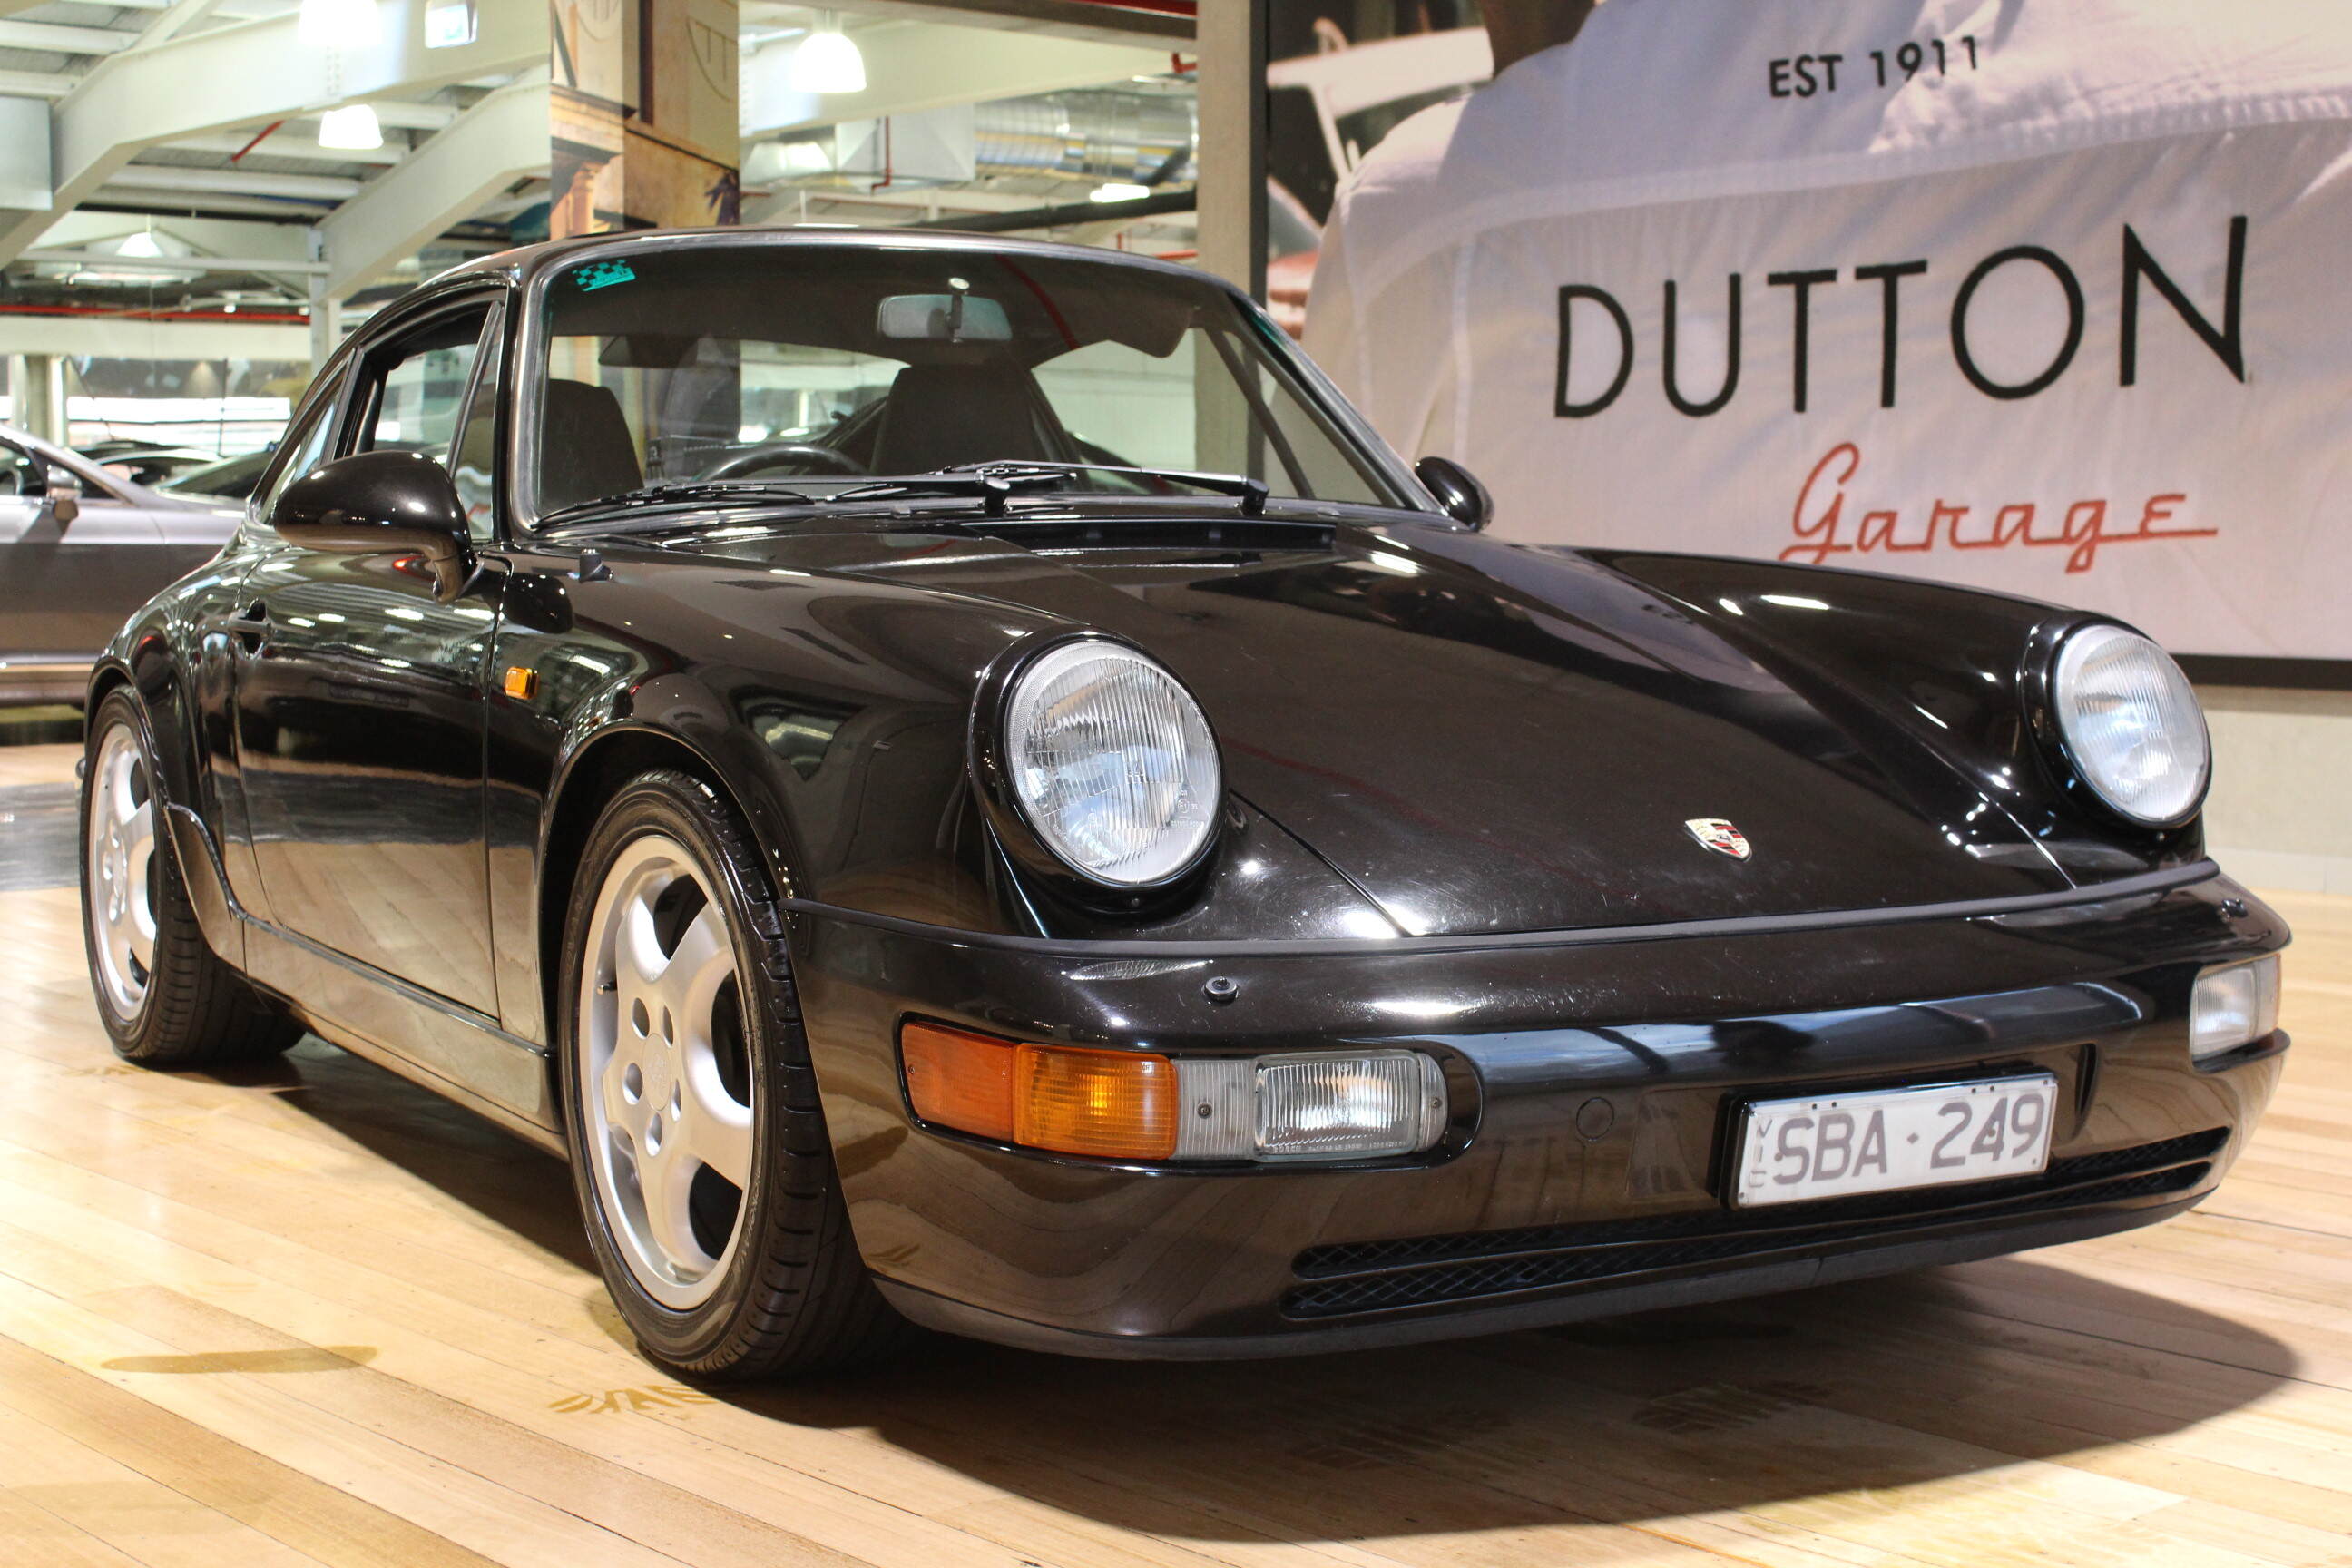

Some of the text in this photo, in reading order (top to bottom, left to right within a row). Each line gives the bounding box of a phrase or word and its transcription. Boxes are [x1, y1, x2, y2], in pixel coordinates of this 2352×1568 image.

[1769, 35, 1979, 99] EST 1911
[1554, 216, 2248, 419] DUTTON
[1778, 442, 2219, 574] Garage
